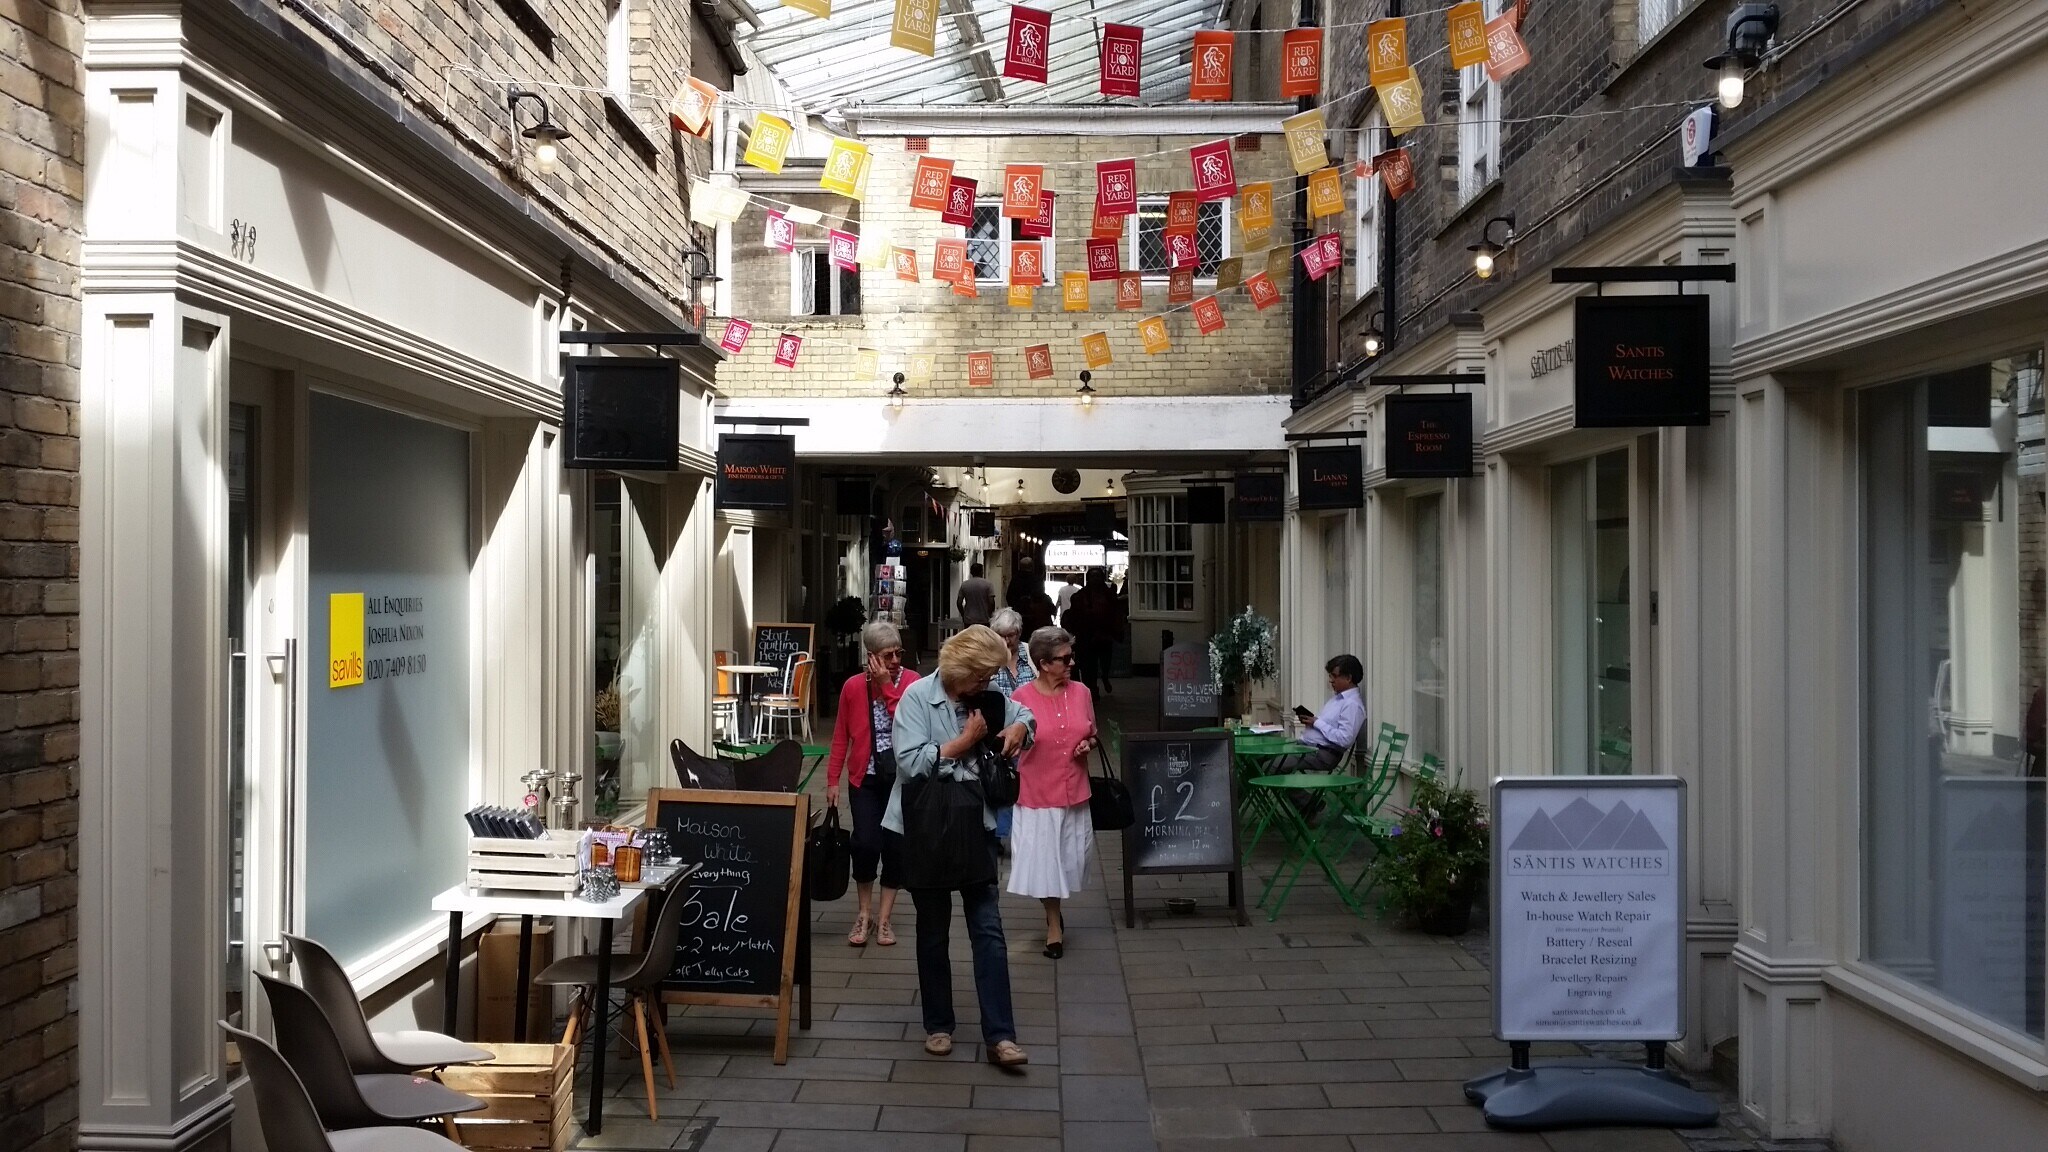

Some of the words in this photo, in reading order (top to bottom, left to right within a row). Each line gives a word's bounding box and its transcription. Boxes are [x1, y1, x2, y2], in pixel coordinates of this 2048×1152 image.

[906, 6, 930, 22] LION
[904, 16, 930, 33] YARD
[1458, 17, 1477, 29] RED
[1457, 26, 1480, 40] LION
[1488, 30, 1508, 46] RED
[1113, 43, 1133, 54] RED
[1457, 36, 1482, 50] YARD
[1016, 46, 1042, 60] LION
[1294, 46, 1314, 56] RED
[1491, 45, 1518, 63] YARD
[1111, 53, 1134, 65] LION
[1291, 56, 1315, 67] LION
[1378, 52, 1400, 65] LION
[1109, 63, 1136, 76] YARD
[1201, 68, 1226, 79] LION
[1291, 66, 1317, 77] YARD
[1393, 102, 1418, 116] LION
[762, 127, 779, 138] RED
[756, 141, 776, 155] YARD
[1298, 143, 1325, 158] YARD
[832, 164, 853, 177] LION
[925, 170, 943, 180] RED
[922, 178, 943, 188] LION
[1108, 174, 1127, 183] RED
[1202, 171, 1227, 184] LION
[920, 185, 943, 197] YARD
[1106, 182, 1129, 192] LION
[1011, 193, 1034, 202] LION
[1106, 191, 1130, 200] YARD
[1317, 193, 1338, 203] YARD
[950, 202, 969, 212] LION
[1099, 216, 1119, 224] LION
[943, 248, 958, 256] RED
[1094, 254, 1113, 262] LION
[940, 261, 959, 270] YARD
[1017, 265, 1036, 273] LION
[1094, 261, 1114, 269] YARD
[1615, 343, 1665, 358] SANTIS
[1608, 365, 1674, 380] WATCHES
[1408, 431, 1451, 441] ESPRESSO
[1415, 442, 1442, 452] ROOM
[725, 463, 758, 474] MAISON
[759, 464, 787, 475] WHITE
[1312, 468, 1348, 482] LIANA'S
[368, 597, 382, 615] ALL
[384, 595, 423, 617] ENQUIRIES
[368, 626, 398, 648] JOSHUA
[399, 624, 424, 642] NIXON
[761, 628, 792, 641] Start
[758, 639, 799, 653] quitting
[759, 651, 787, 661] here
[332, 651, 362, 682] savills
[367, 658, 384, 680] 020
[386, 656, 406, 678] 7409
[407, 653, 427, 675] 8150
[1167, 683, 1185, 695] ALL
[677, 816, 746, 840] Maison
[1144, 826, 1191, 838] MORNING
[703, 842, 758, 864] White
[1513, 854, 1576, 869] SÄNTIS
[1583, 856, 1663, 869] WATCHES
[1521, 891, 1556, 902] Watch
[1558, 891, 1568, 902] &
[1572, 890, 1624, 905] Jewellery
[1627, 890, 1657, 902] Sales
[680, 889, 749, 933] Sale
[1526, 911, 1574, 922] In-house
[1578, 911, 1612, 922] Watch
[1615, 911, 1651, 924] Repair
[691, 937, 704, 954] 2
[1546, 937, 1586, 949] Battery
[1597, 936, 1633, 947] Reseal
[1542, 954, 1587, 965] Bracelet
[1591, 954, 1637, 967] Resizing
[1551, 973, 1592, 984] Jewellery
[1595, 974, 1628, 984] Repairs
[1567, 988, 1612, 999] Engraving
